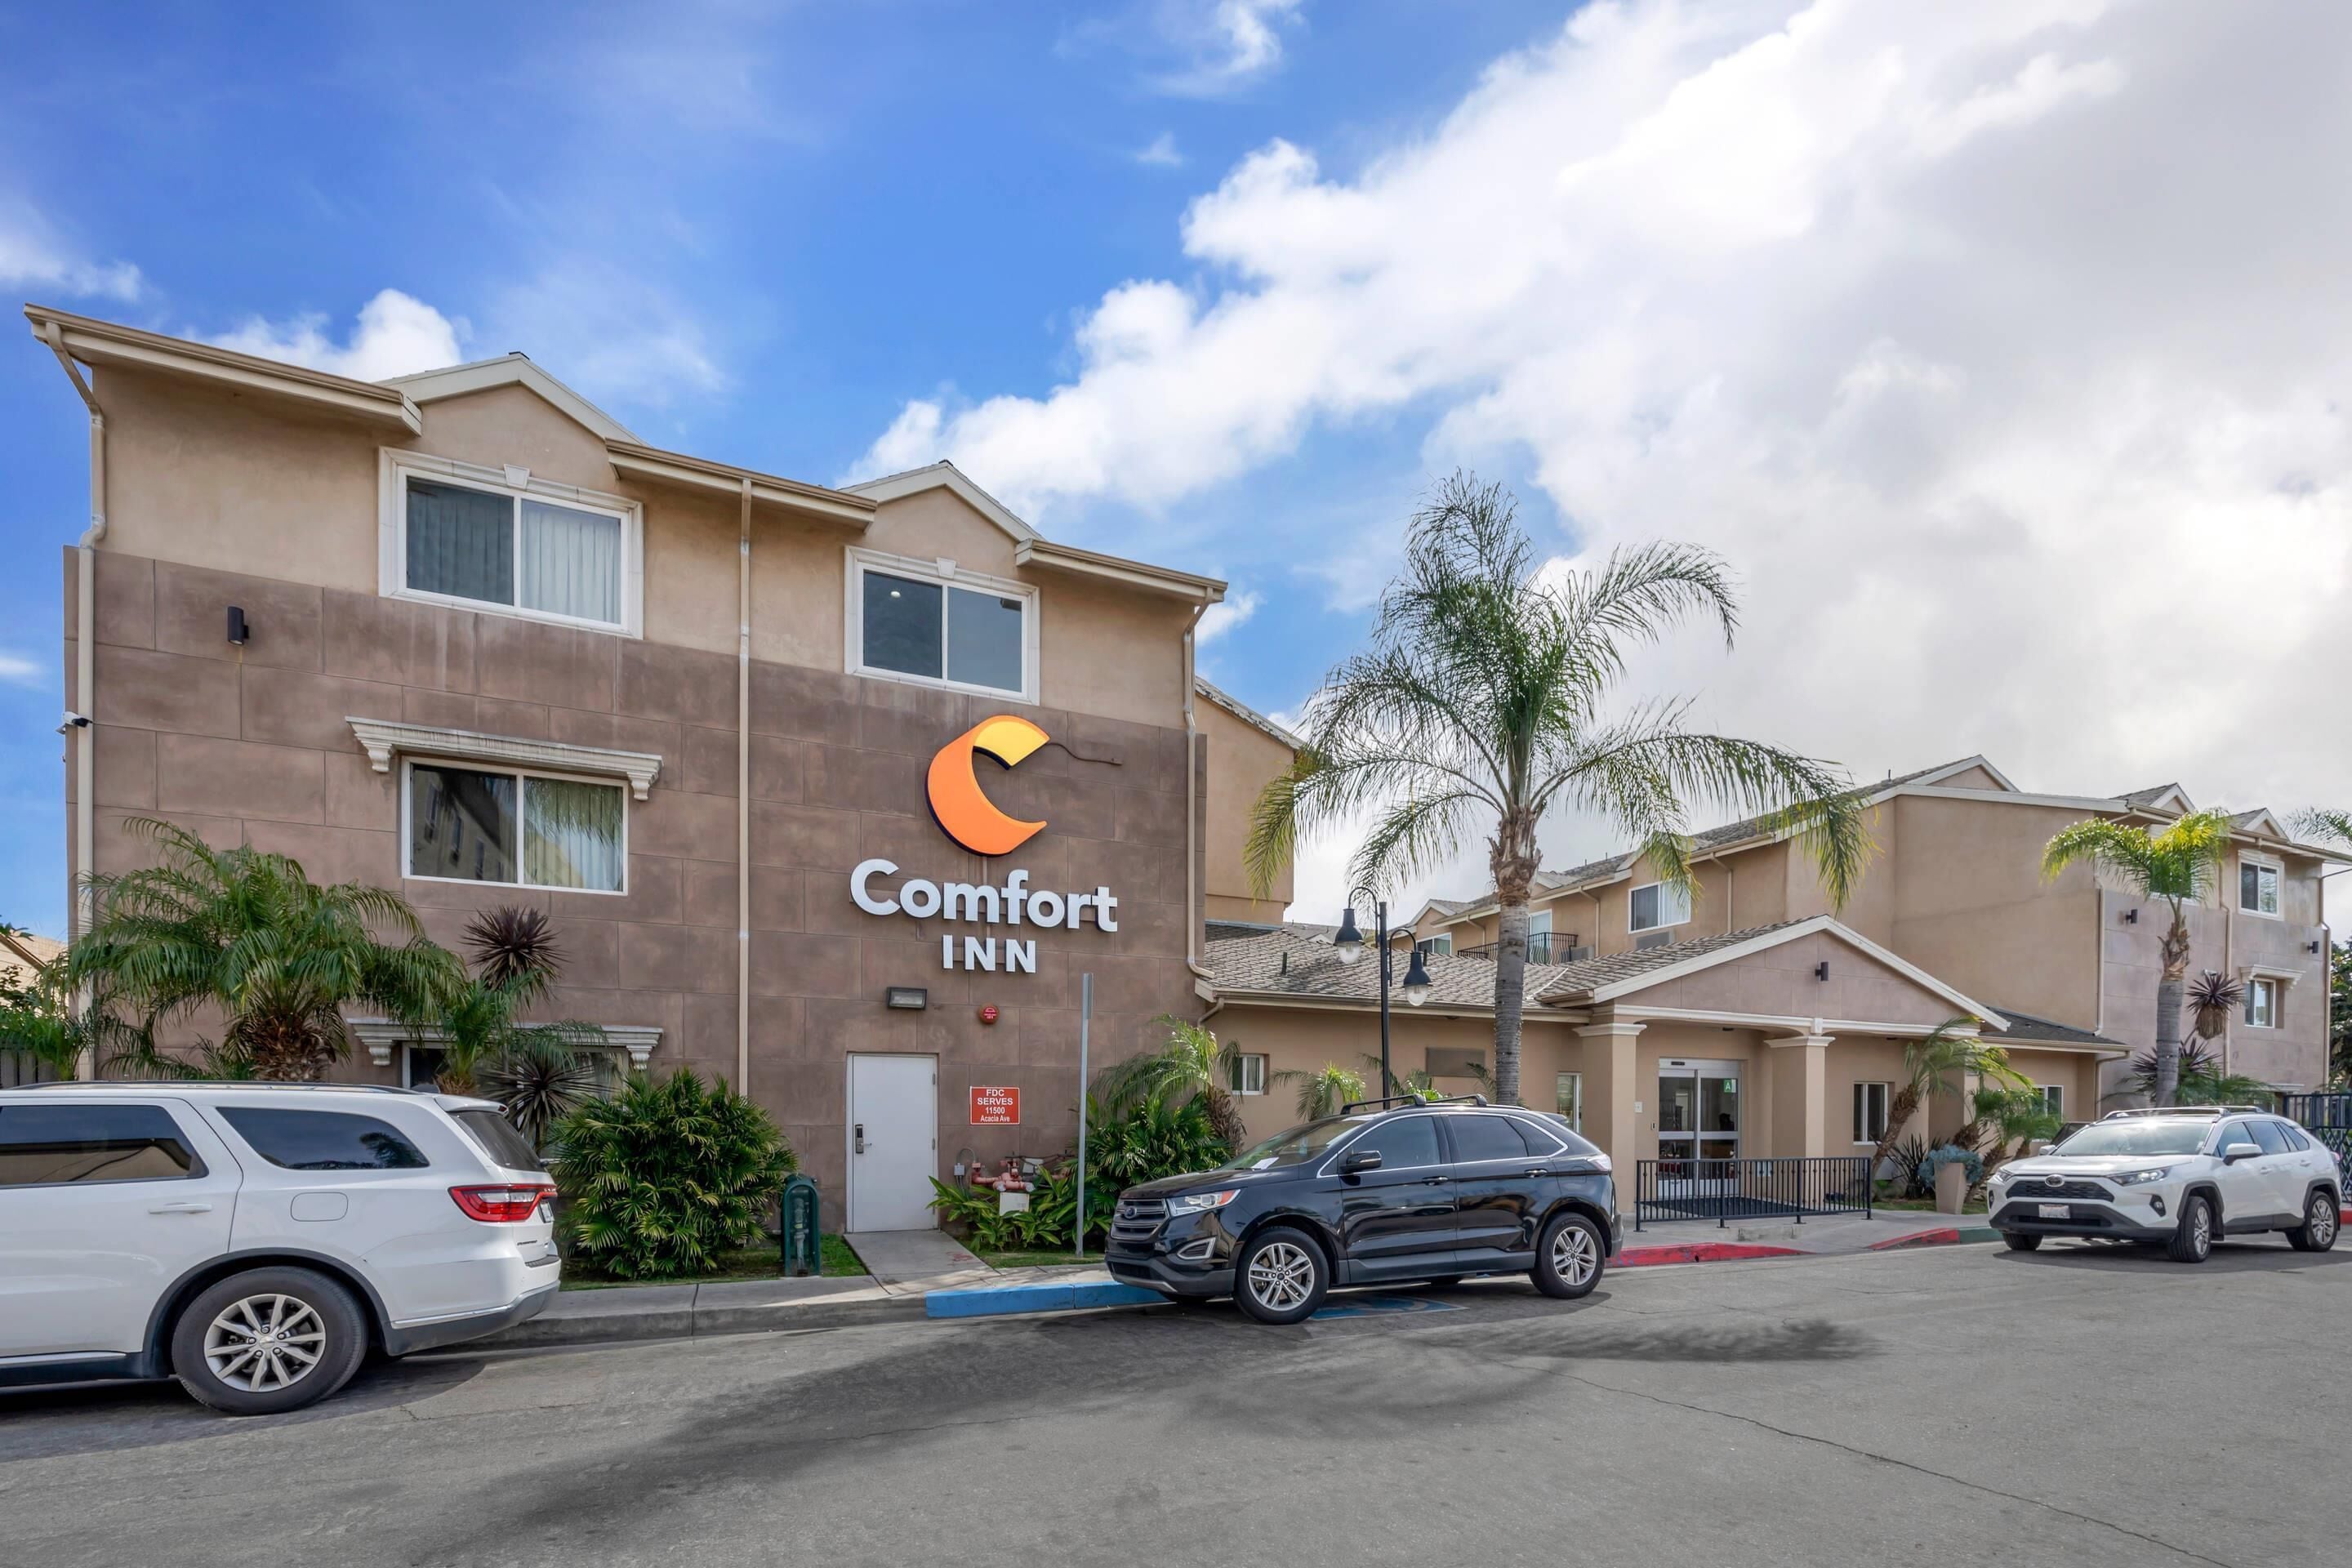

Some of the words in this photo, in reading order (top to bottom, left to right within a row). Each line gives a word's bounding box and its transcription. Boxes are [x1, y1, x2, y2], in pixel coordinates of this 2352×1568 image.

[850, 858, 1118, 932] Comfort
[942, 934, 1036, 973] INN
[977, 1097, 1013, 1105] SERVES
[986, 1089, 1004, 1097] FDC
